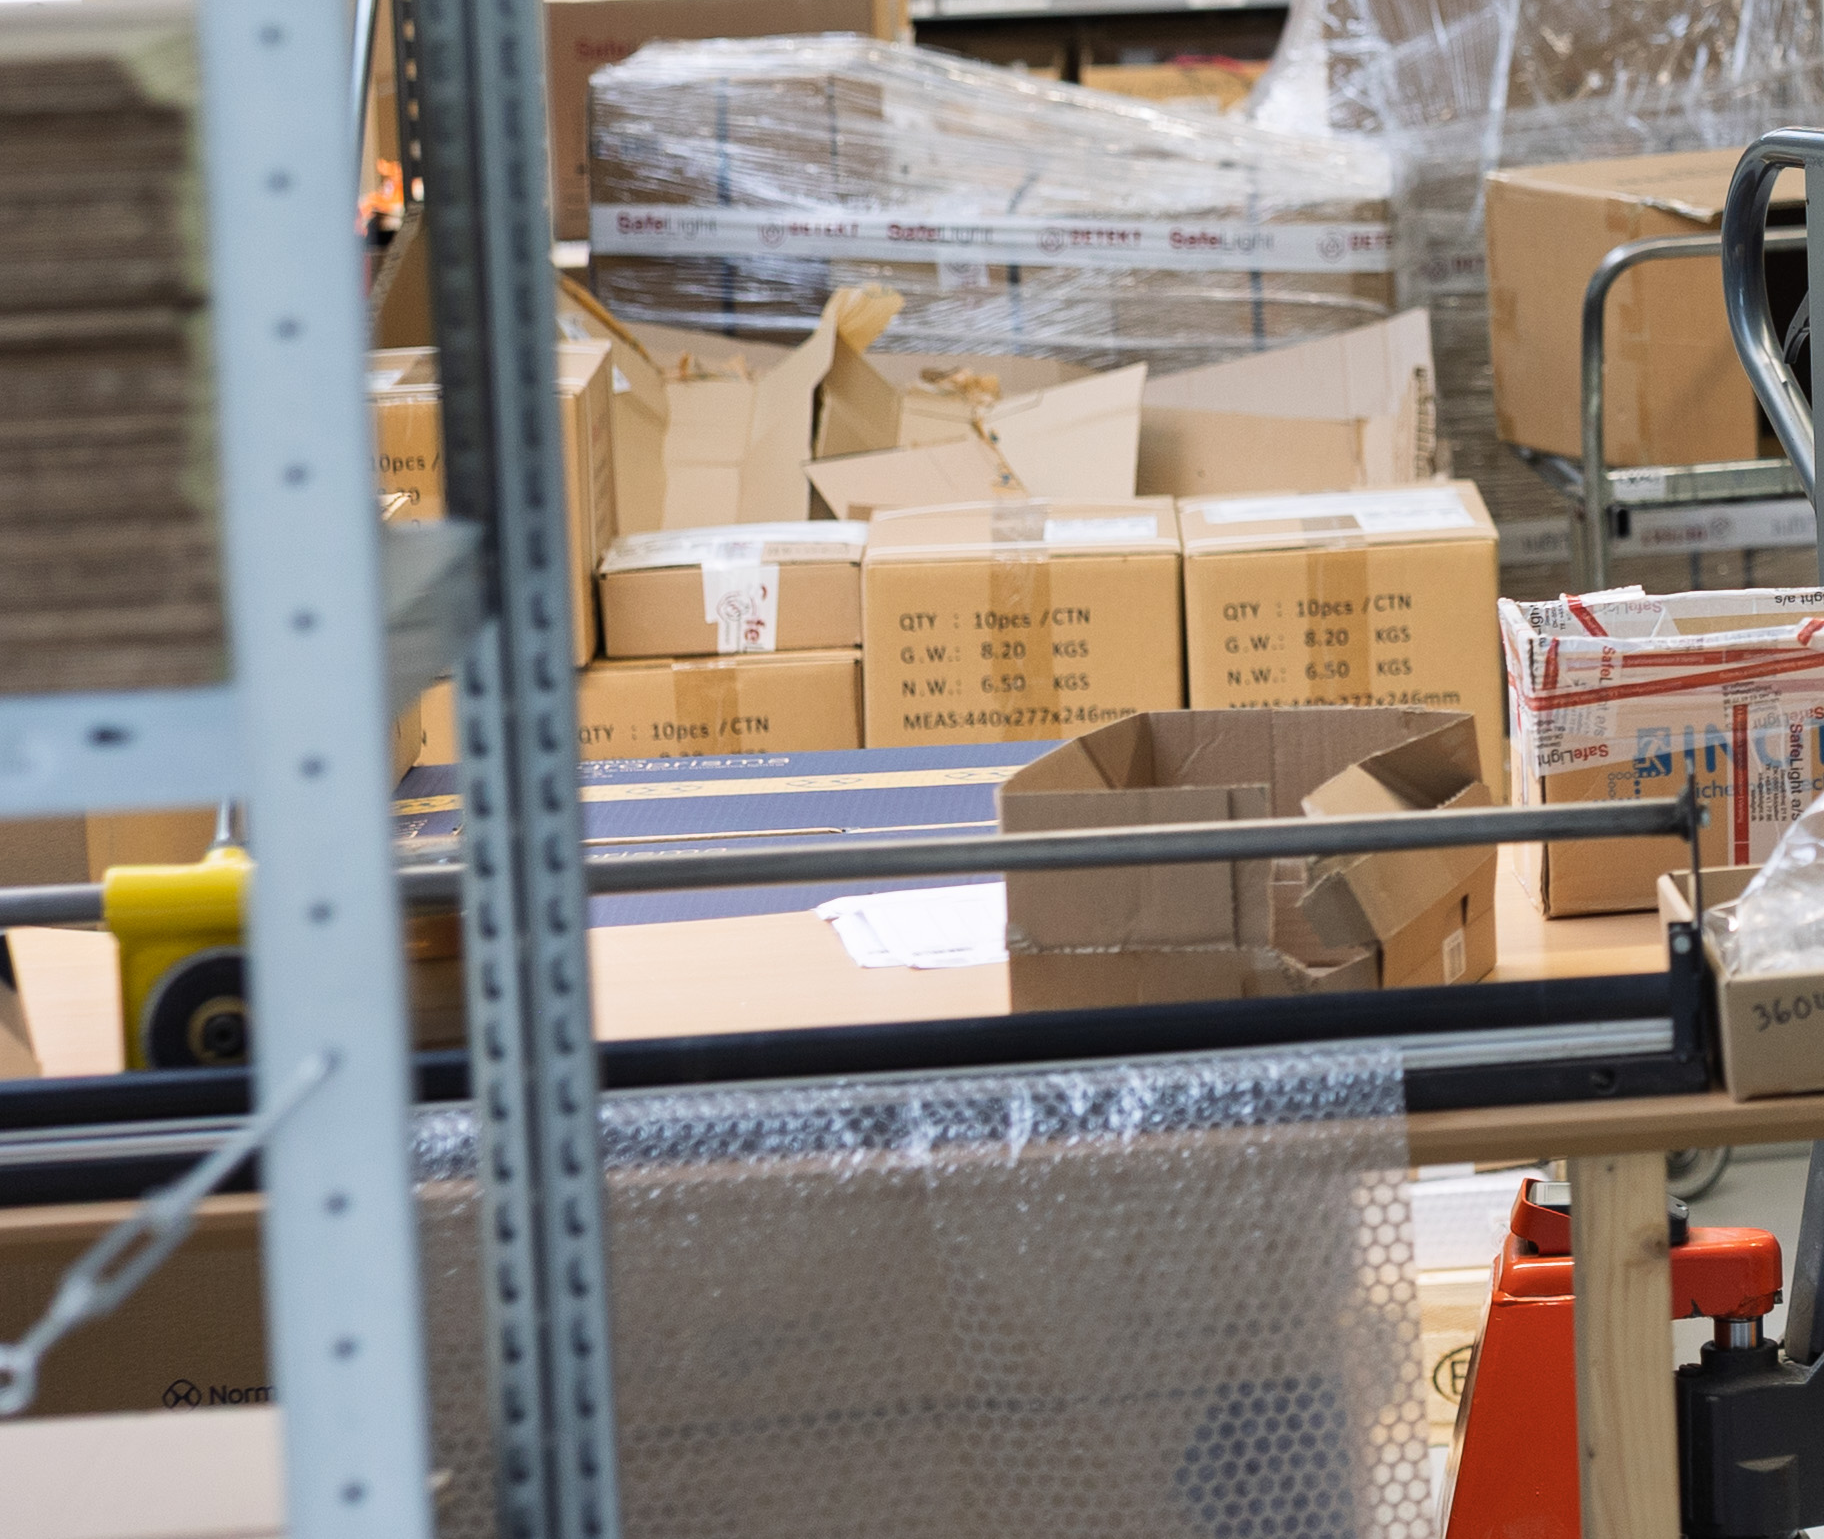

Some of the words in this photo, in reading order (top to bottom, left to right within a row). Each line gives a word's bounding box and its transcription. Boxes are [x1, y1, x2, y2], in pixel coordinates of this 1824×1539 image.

[899, 612, 938, 633] QTY
[973, 610, 1031, 632] 10pcs
[1222, 602, 1260, 623] QTY
[1296, 598, 1354, 620] 10pcs
[1304, 627, 1349, 648] 8.20
[1374, 625, 1411, 645] KGS
[980, 641, 1027, 660] 8.20
[1051, 639, 1089, 659] KGS
[1304, 660, 1350, 681] 6.50
[1376, 658, 1413, 676] KGS
[980, 674, 1027, 693] 6.50
[1052, 672, 1090, 691] KGS
[652, 721, 710, 742] 10pcs
[1536, 743, 1610, 768] SafeLight
[1788, 723, 1804, 794] SafeLight
